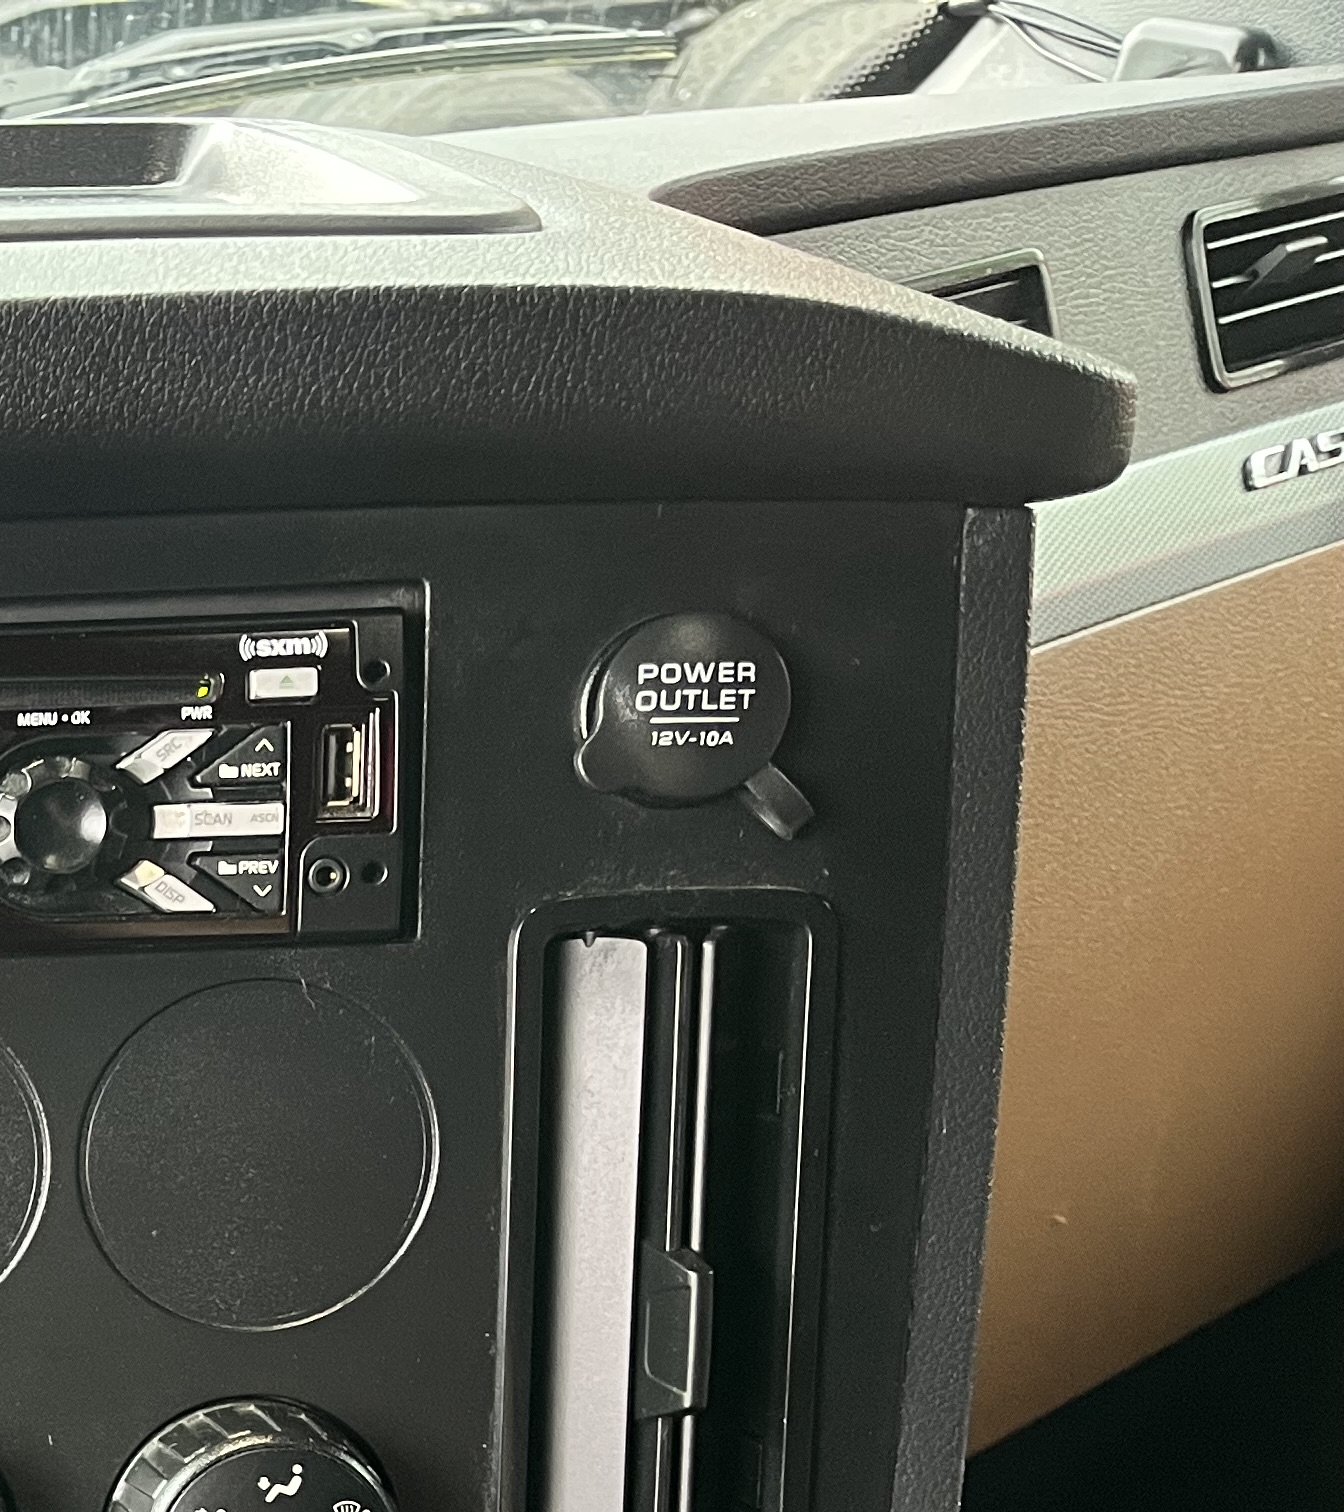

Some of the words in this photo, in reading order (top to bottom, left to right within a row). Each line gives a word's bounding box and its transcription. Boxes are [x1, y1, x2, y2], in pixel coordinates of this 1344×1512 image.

[637, 661, 757, 685] POWER
[634, 688, 756, 712] OUTLET
[16, 712, 58, 727] MENU
[70, 710, 91, 725] OK
[180, 705, 213, 721] PWR
[650, 730, 734, 746] 12V-10A
[155, 736, 183, 762] SRC
[240, 762, 281, 778] NEXT
[193, 812, 233, 827] SCAN
[238, 860, 279, 875] PREV
[154, 880, 186, 905] DISP
